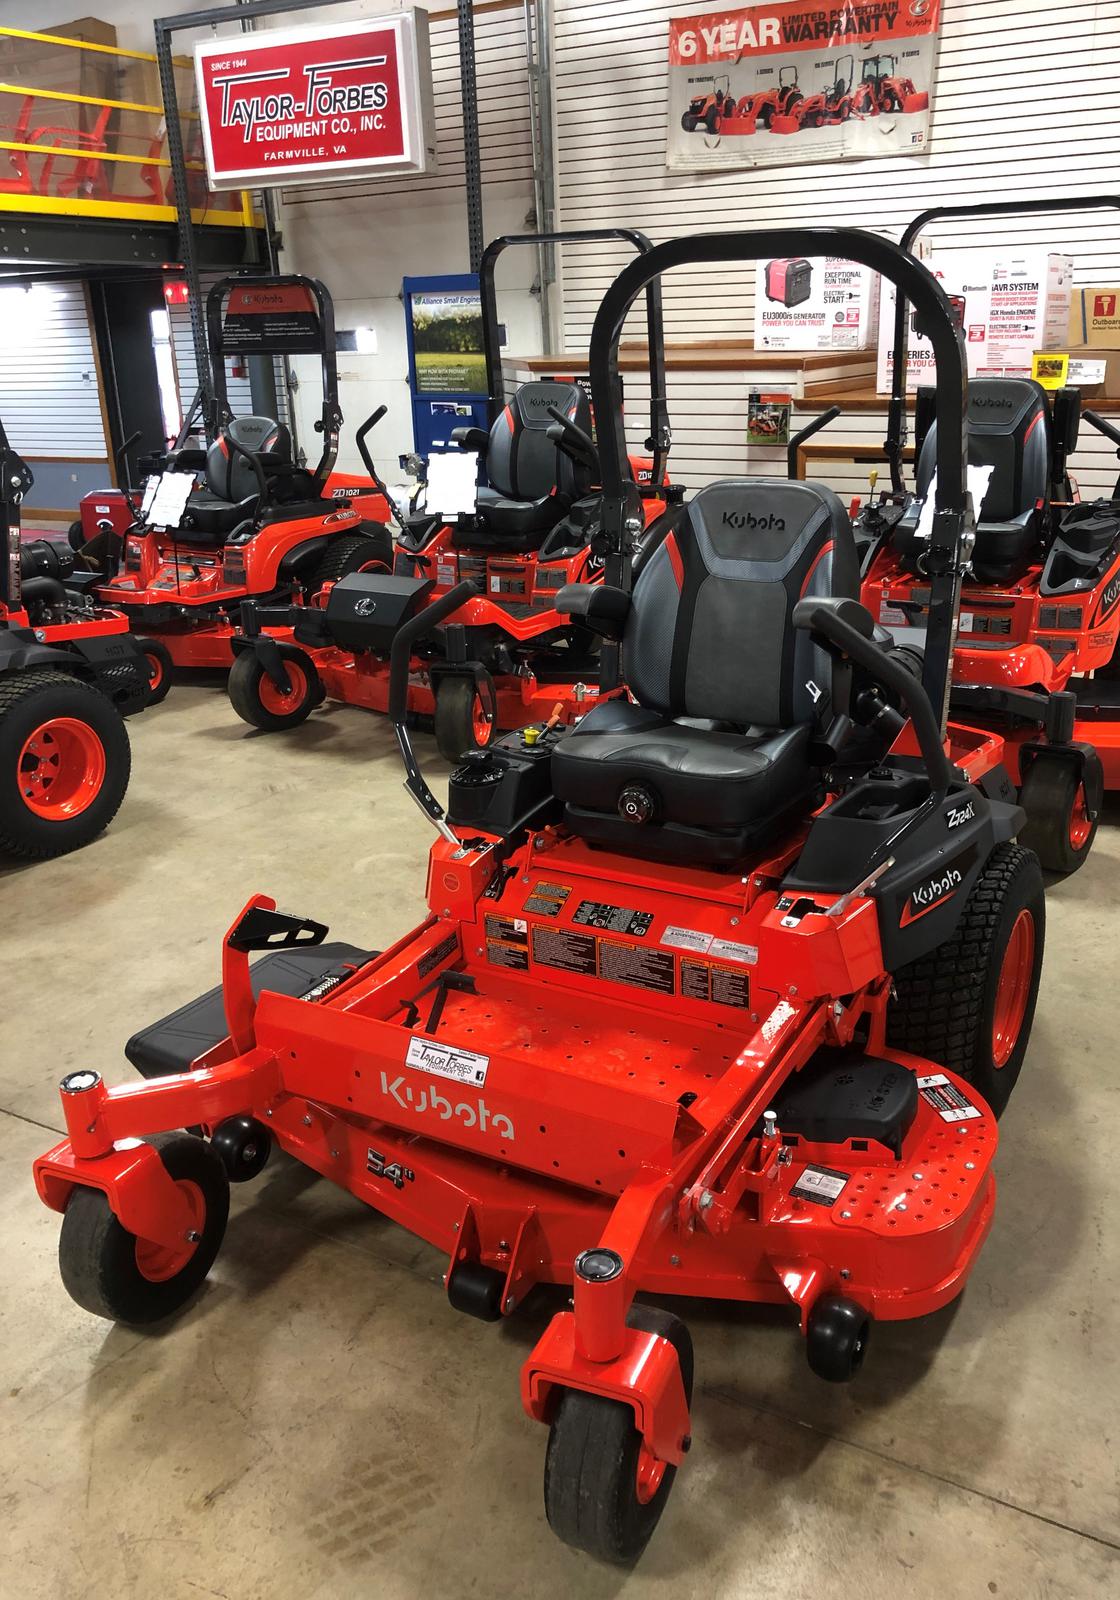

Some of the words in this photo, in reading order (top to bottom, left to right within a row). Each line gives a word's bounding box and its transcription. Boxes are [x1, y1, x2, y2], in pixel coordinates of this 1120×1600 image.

[782, 10, 825, 25] LIMITED
[830, 1, 899, 20] POWERTRAIN
[782, 11, 898, 43] WARRANTY
[678, 30, 697, 57] 6
[701, 17, 781, 55] YEAR
[210, 61, 231, 72] SINCE
[232, 58, 247, 69] 1944
[256, 119, 327, 142] EQUIPMENT
[331, 117, 357, 135] CO.,
[360, 115, 386, 132] INC.
[264, 147, 329, 161] FARMVILLE,
[333, 145, 347, 154] VA
[1009, 282, 1039, 291] SYSTEM
[422, 297, 443, 305] Alliance
[443, 296, 459, 304] Small
[824, 296, 845, 304] START
[794, 312, 826, 320] GENERATOR
[907, 350, 930, 359] ERIES
[913, 359, 927, 367] YOU
[928, 359, 936, 367] CA
[530, 398, 558, 407] Kubota
[972, 397, 1013, 408] Kubota
[722, 511, 786, 531] Kubota
[912, 869, 962, 905] Kubota
[420, 1044, 449, 1067] TAYLOR
[445, 1052, 477, 1075] FORBES
[380, 1070, 515, 1140] Kubota
